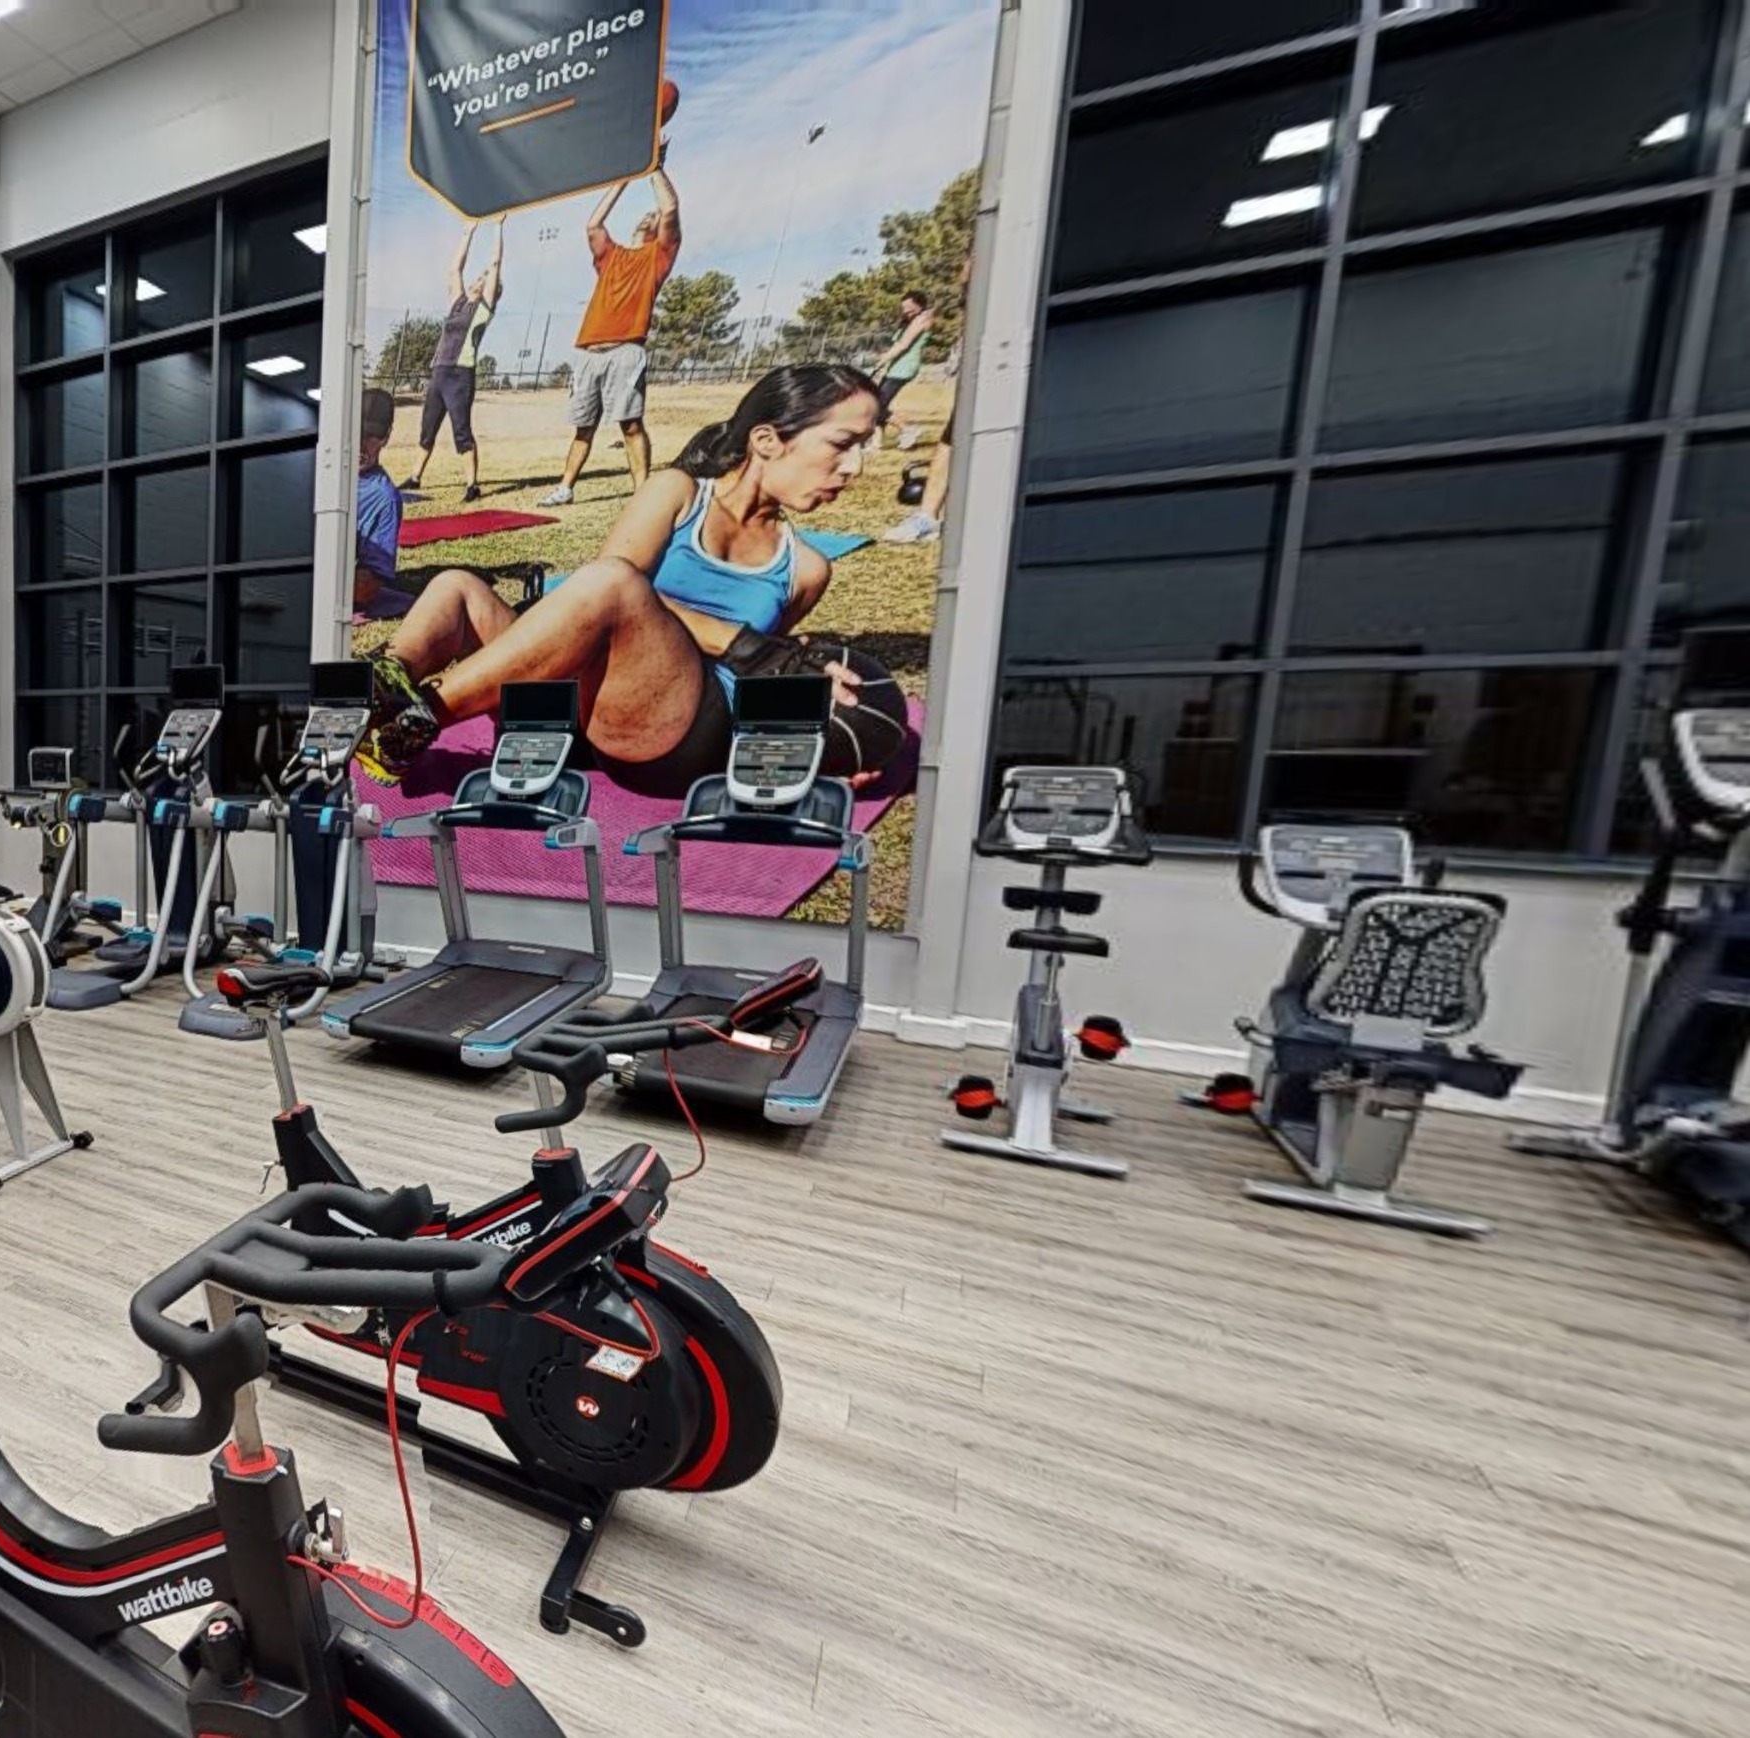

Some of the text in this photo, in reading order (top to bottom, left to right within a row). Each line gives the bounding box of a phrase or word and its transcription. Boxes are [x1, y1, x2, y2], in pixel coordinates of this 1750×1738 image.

[428, 8, 645, 94] “Whatever place
[453, 46, 609, 126] you’re into.”
[117, 1576, 215, 1622] wattbike
